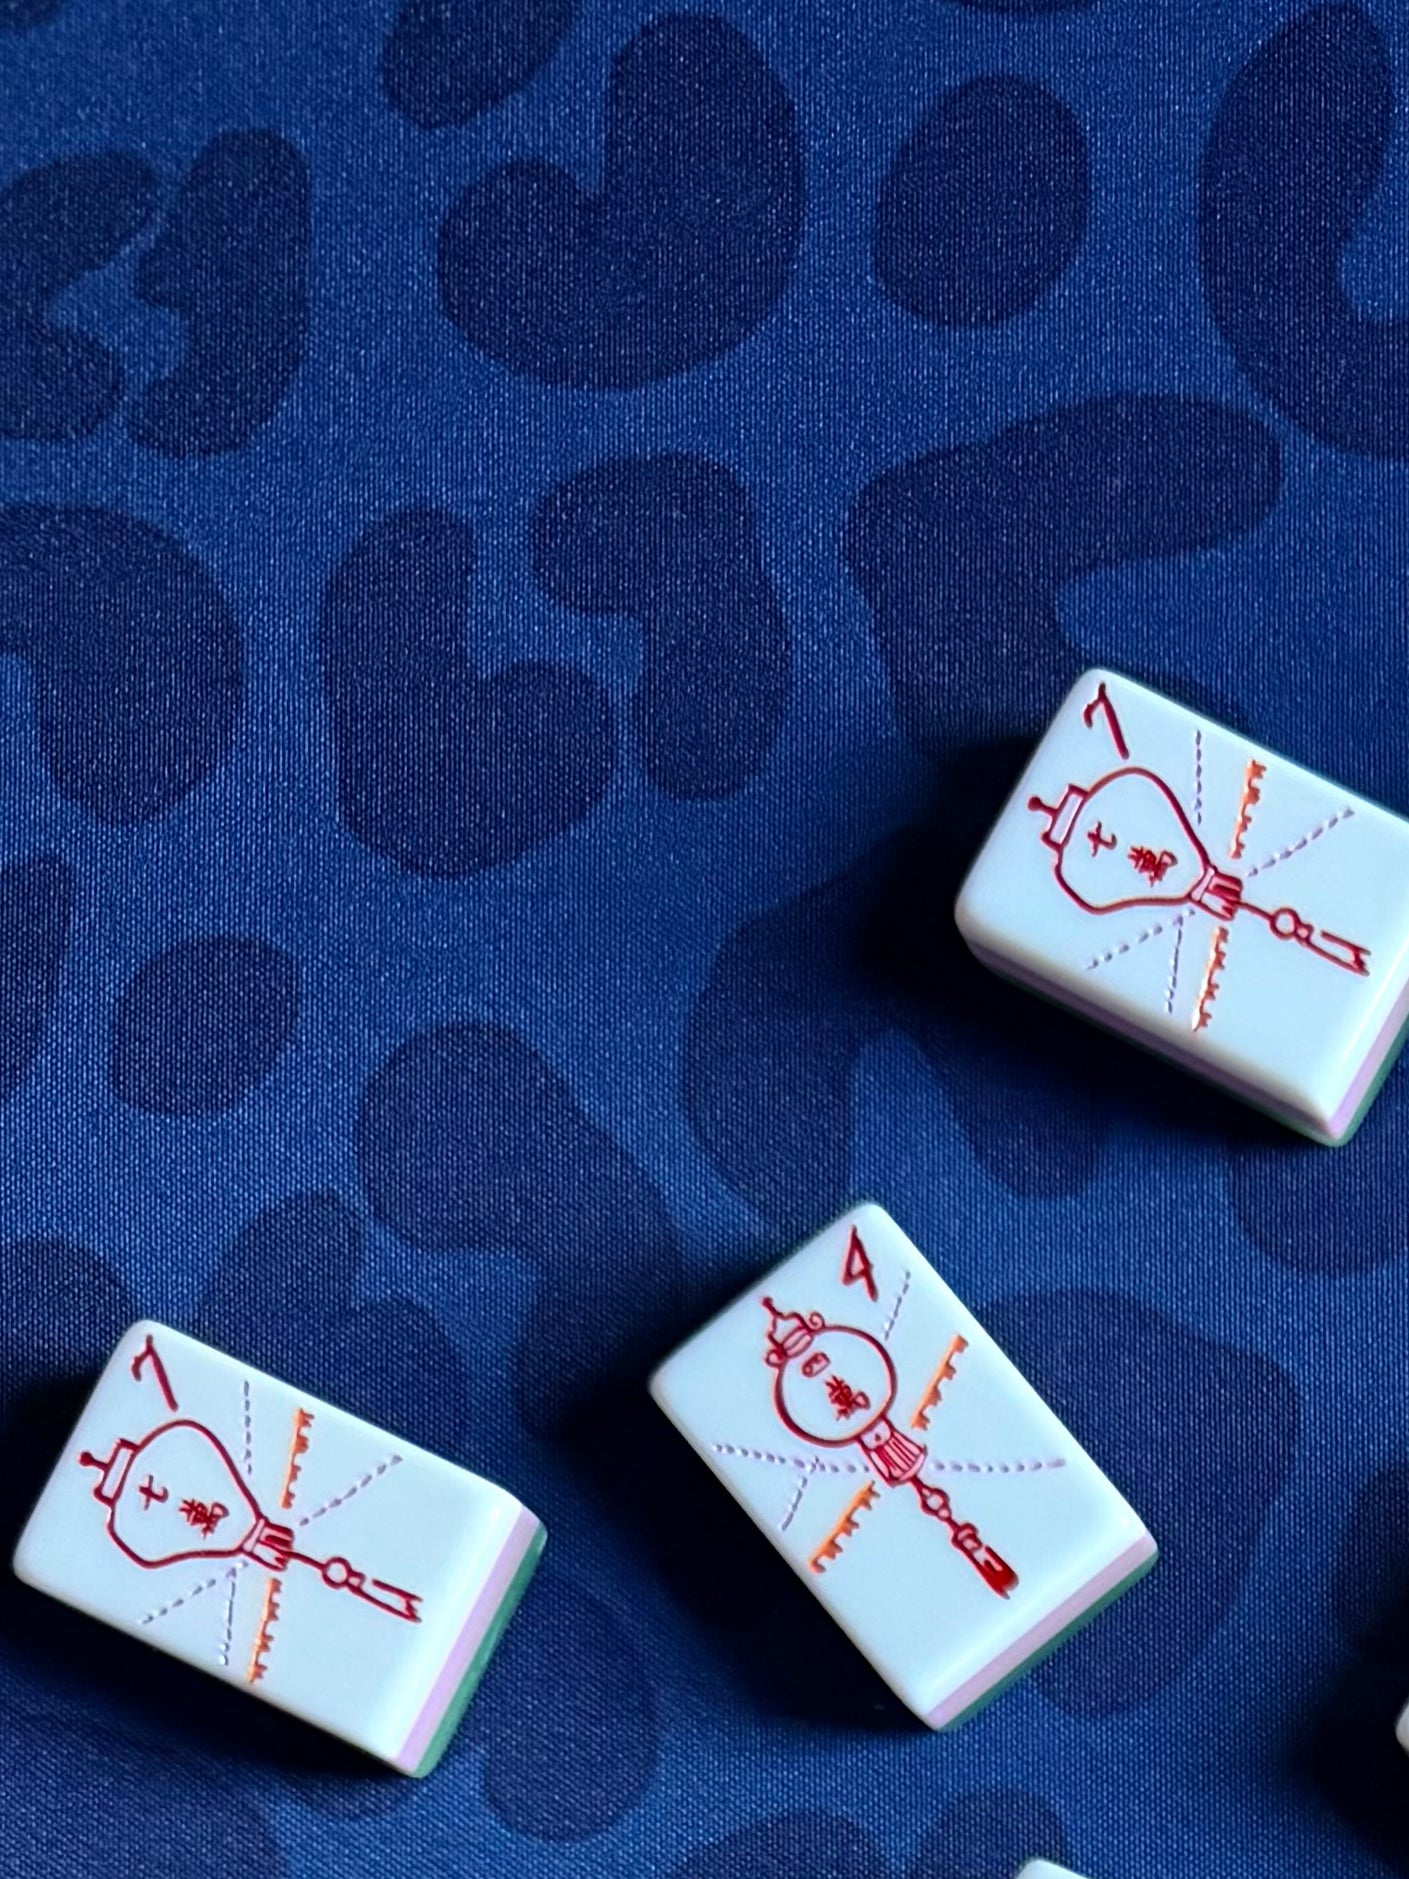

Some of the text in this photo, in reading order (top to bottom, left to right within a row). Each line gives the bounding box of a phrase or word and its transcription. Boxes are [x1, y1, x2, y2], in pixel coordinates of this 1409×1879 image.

[1082, 681, 1130, 760] 7
[842, 1225, 879, 1302] 4
[130, 1334, 179, 1412] 7
